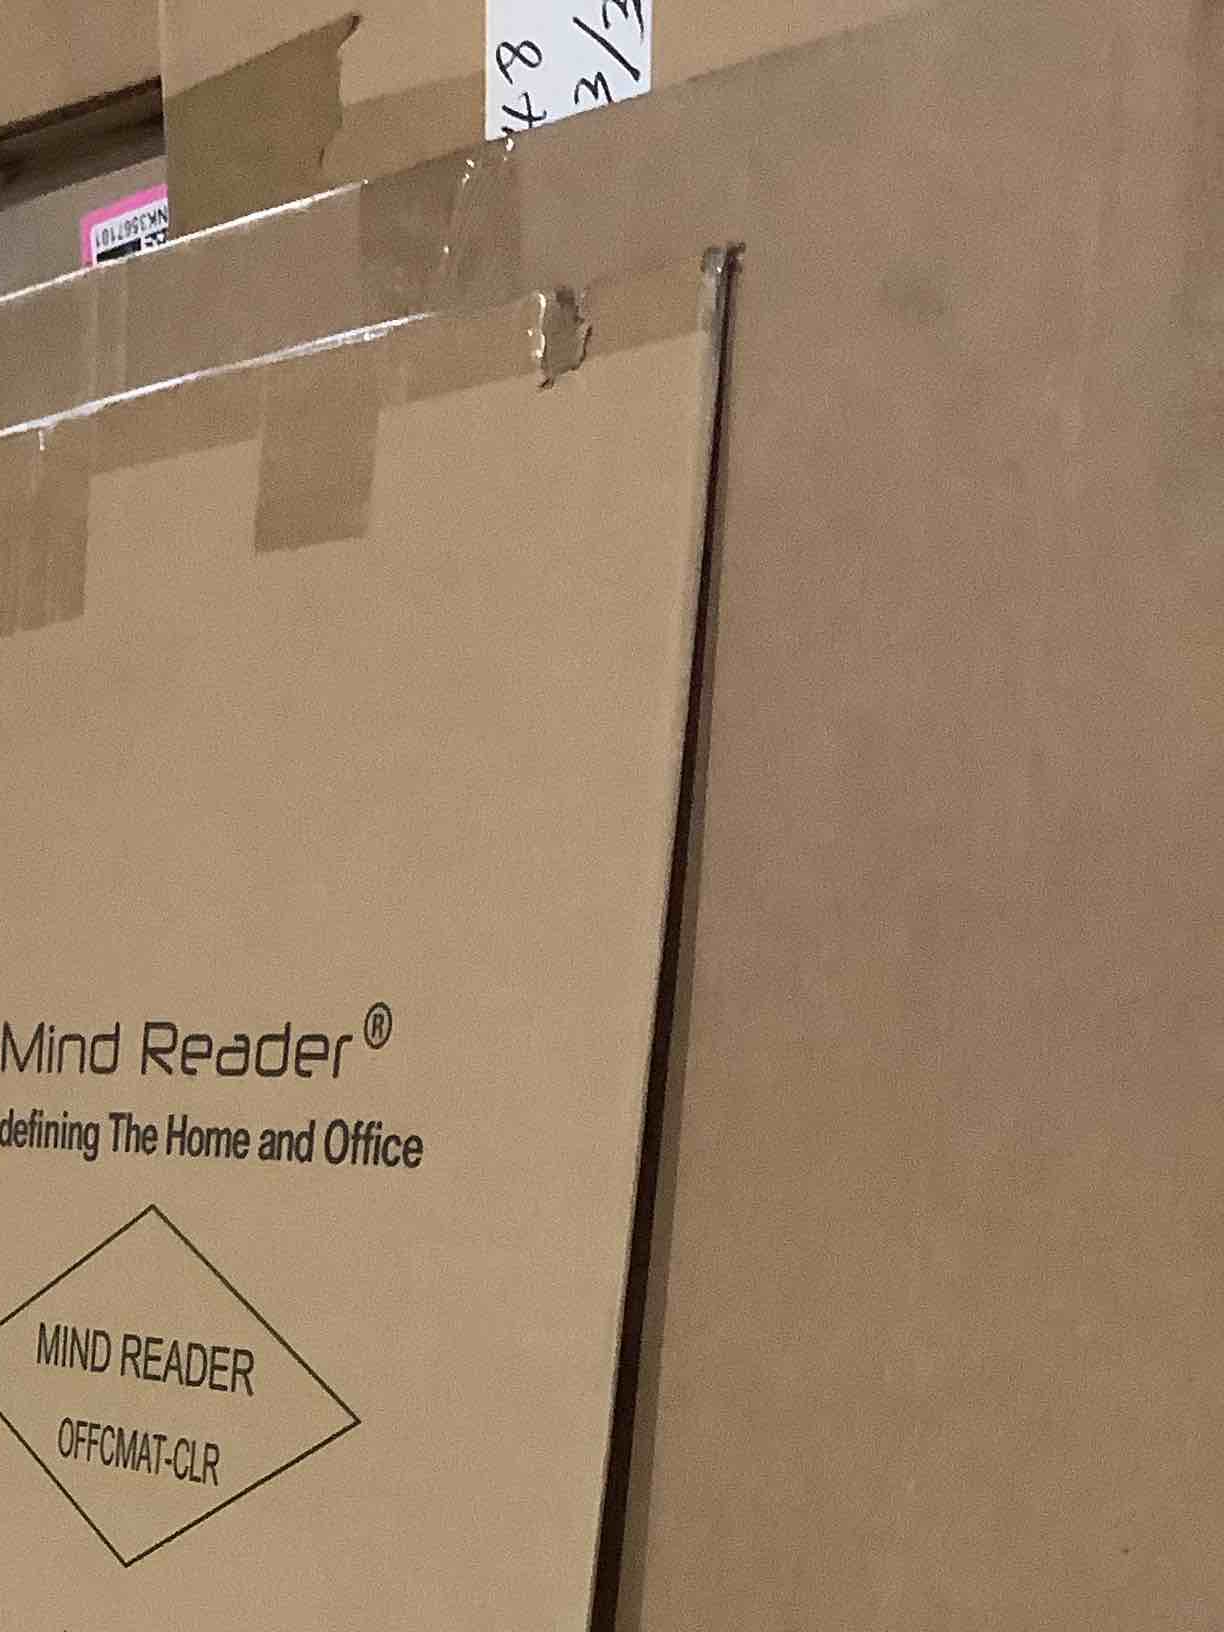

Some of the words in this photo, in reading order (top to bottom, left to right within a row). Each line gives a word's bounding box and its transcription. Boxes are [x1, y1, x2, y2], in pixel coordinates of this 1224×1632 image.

[1, 1020, 120, 1075] Mind
[109, 1112, 158, 1155] The
[166, 1114, 251, 1160] Home
[258, 1119, 316, 1163] and
[324, 1118, 424, 1169] Office
[36, 1322, 112, 1374] MIND
[120, 1333, 255, 1397] READER
[58, 1416, 221, 1487] OFFCMAT-CLR
